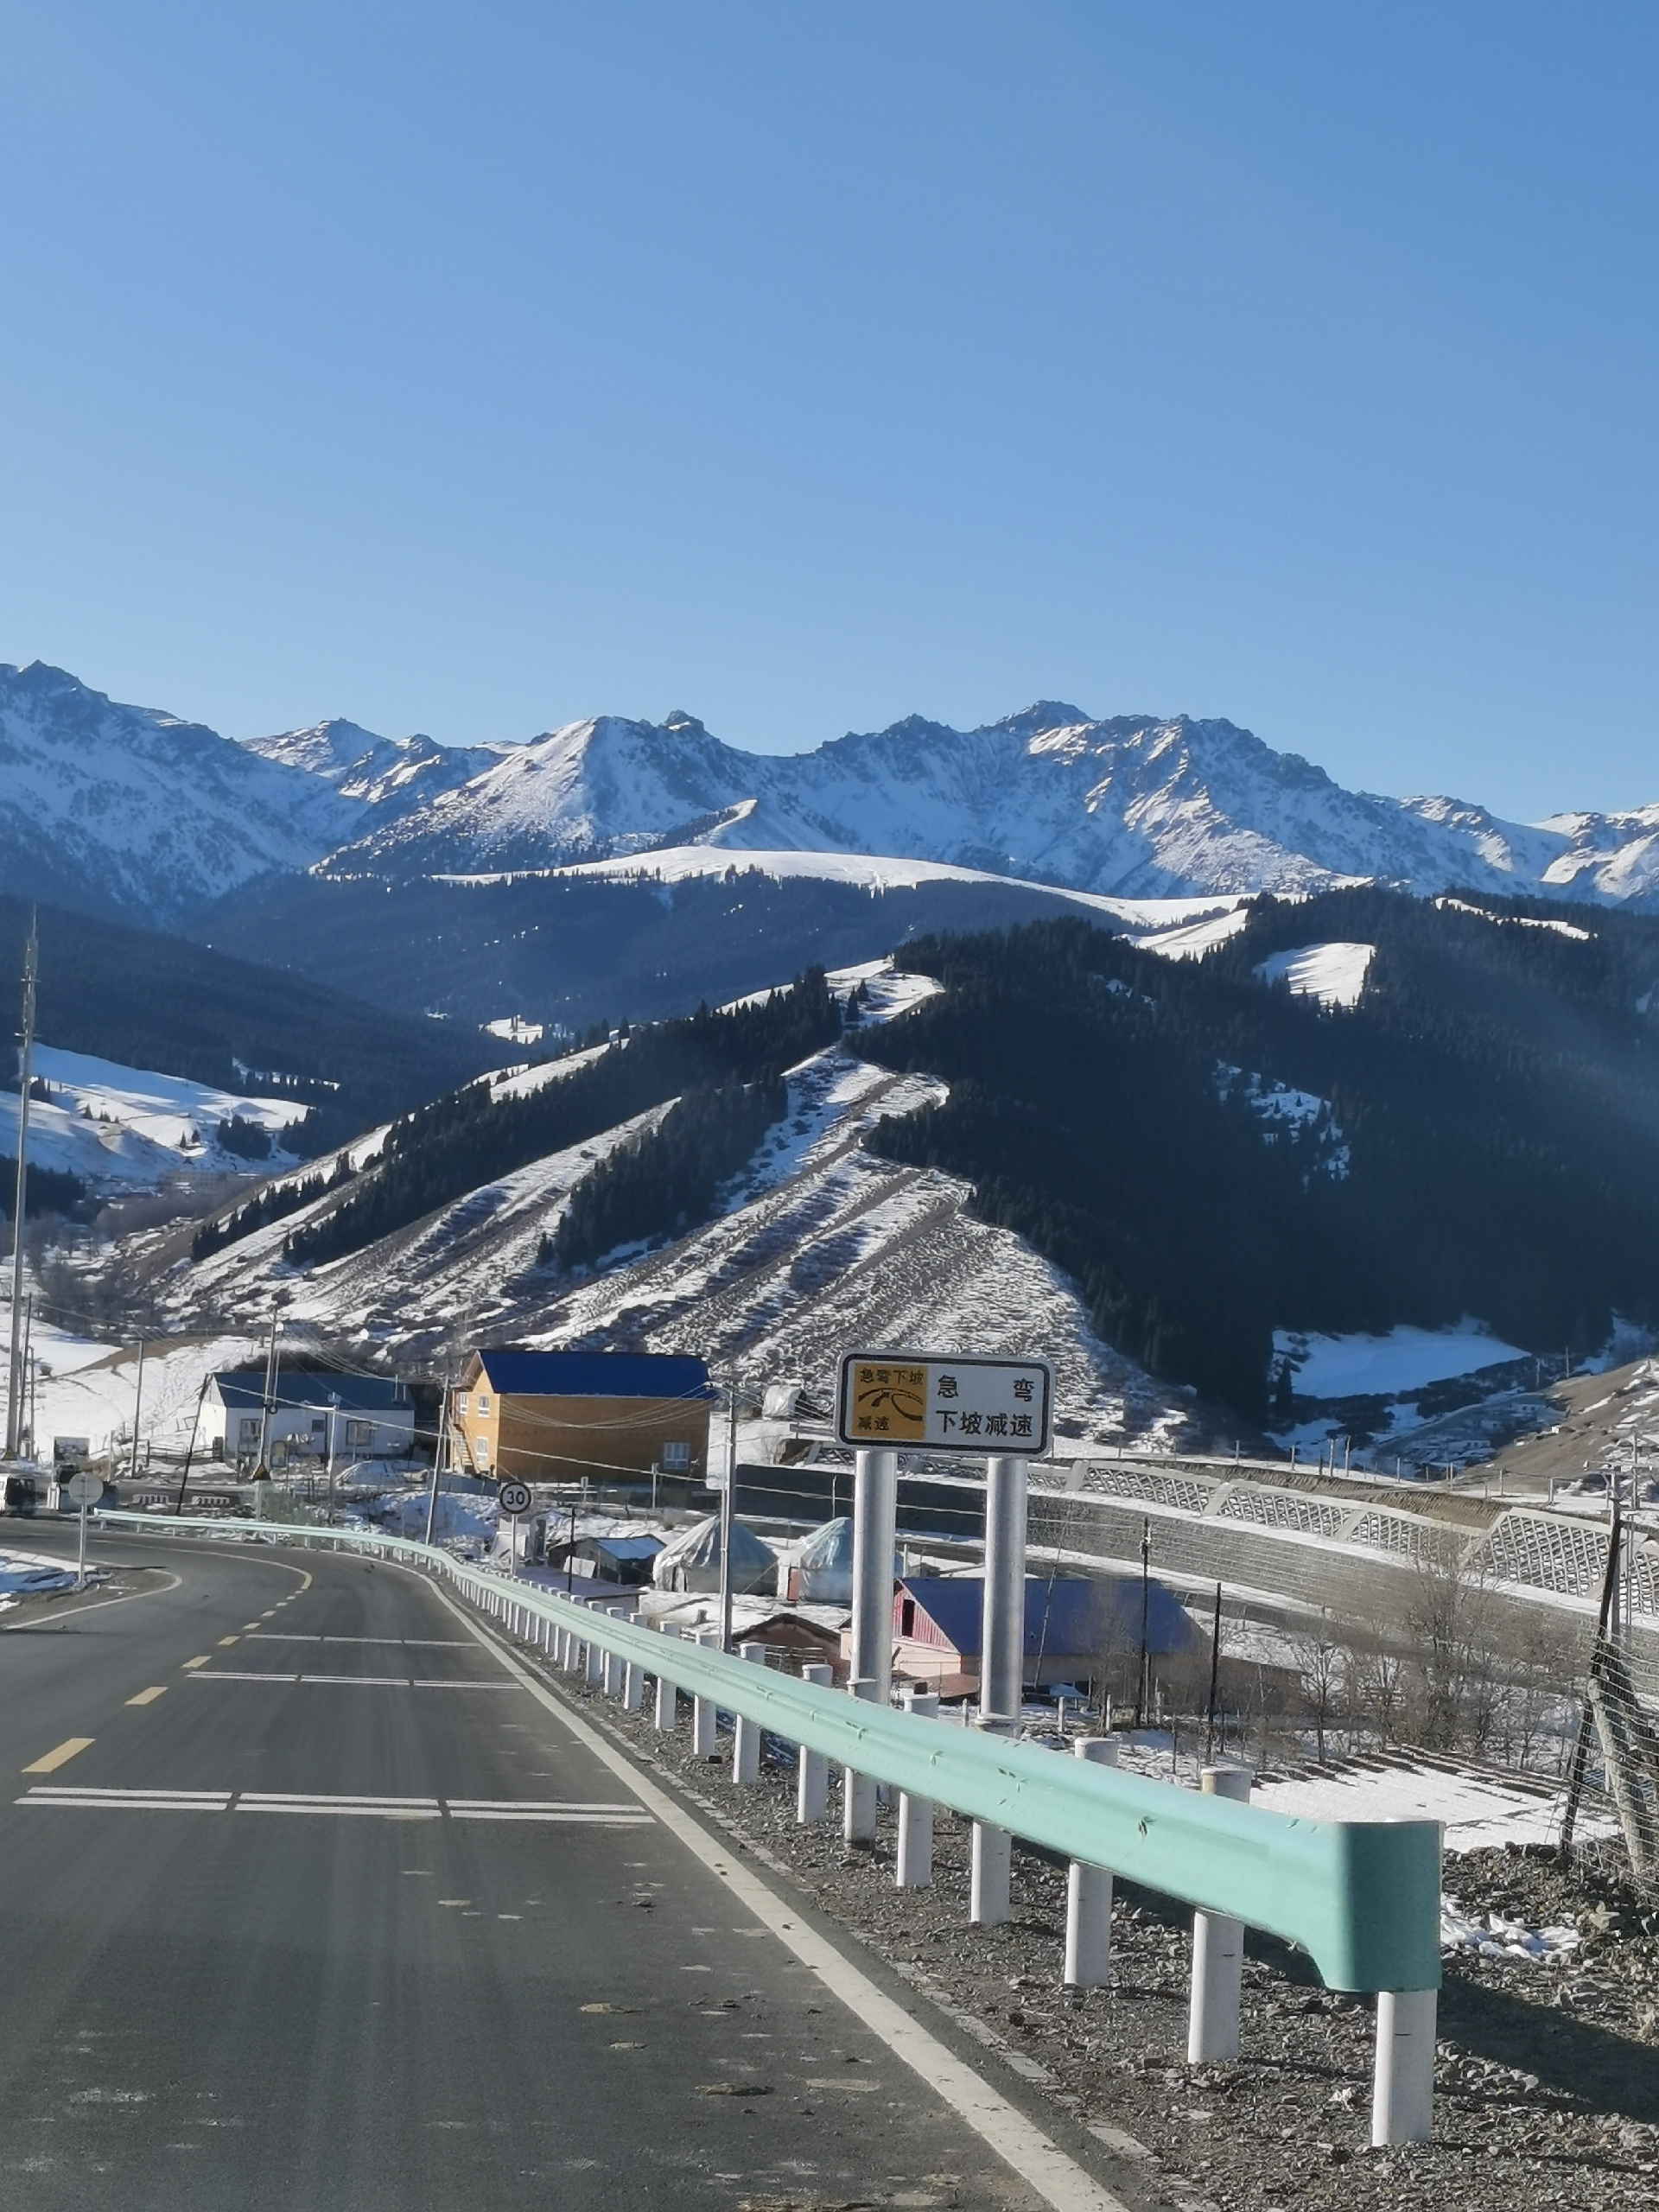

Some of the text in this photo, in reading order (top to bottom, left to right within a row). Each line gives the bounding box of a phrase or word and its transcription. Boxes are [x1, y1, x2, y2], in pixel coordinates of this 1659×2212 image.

[860, 1368, 924, 1385] 急弯下坡
[938, 1376, 1035, 1402] 急 弯
[936, 1410, 1033, 1437] 下坡减速
[506, 1491, 524, 1505] 30
